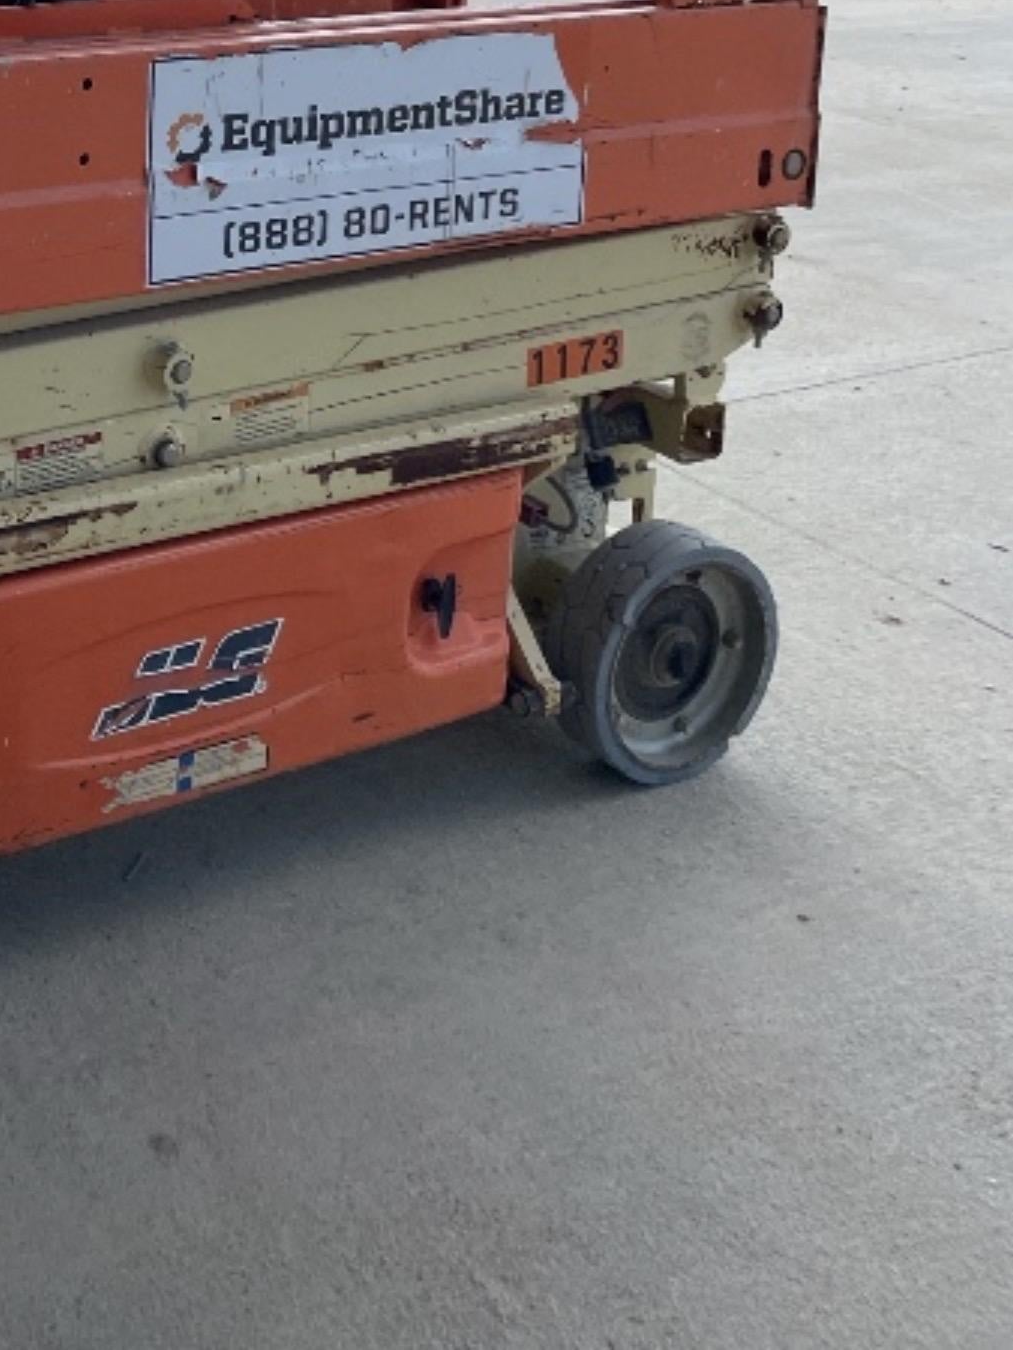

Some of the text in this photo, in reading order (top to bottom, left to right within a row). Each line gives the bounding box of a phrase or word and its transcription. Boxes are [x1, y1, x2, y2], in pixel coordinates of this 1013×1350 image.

[220, 88, 566, 157] EquipmentShare
[222, 188, 520, 259] (888) 80-RENTS
[532, 333, 621, 386] 1173
